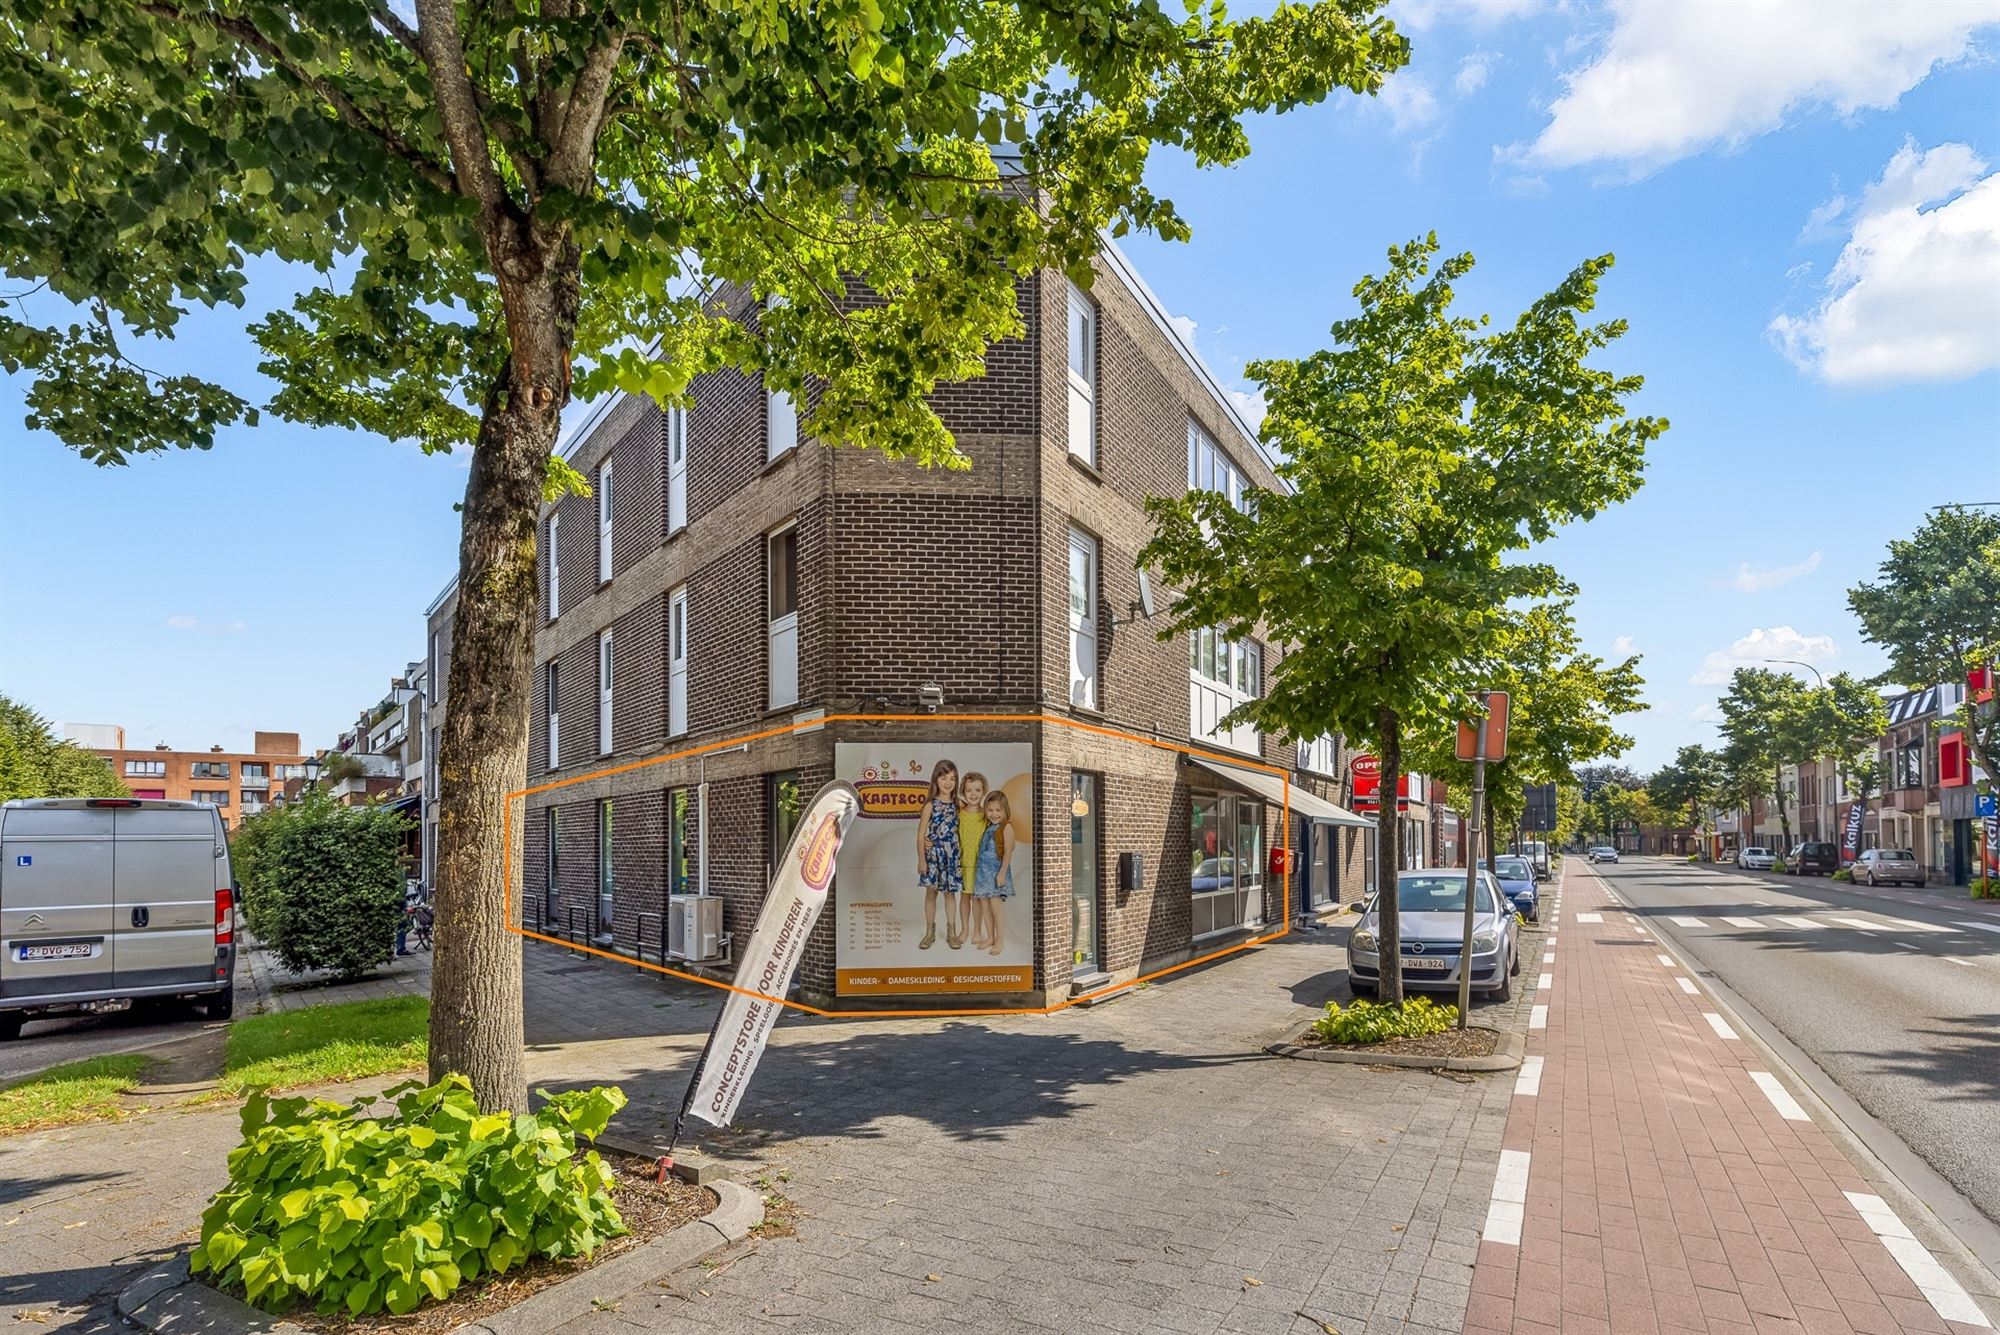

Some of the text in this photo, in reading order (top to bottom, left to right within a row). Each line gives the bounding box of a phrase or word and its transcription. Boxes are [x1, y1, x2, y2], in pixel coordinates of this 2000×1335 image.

[862, 793, 926, 805] KAAT&CO
[1979, 796, 1990, 808] P
[1844, 804, 1861, 849] kalkuz
[1987, 784, 1999, 850] kalz
[20, 857, 29, 865] L
[849, 977, 881, 985] KINDER-
[888, 976, 946, 985] DAMESKLEDING
[953, 975, 1022, 984] DESIGNERSTOFFEN
[711, 1001, 761, 1113] CONCEPTSTORE
[772, 897, 804, 960] KINDEREN
[721, 907, 812, 1118] KINDERKLEDING SPEELGOE ACCESSOIRES EN MEER
